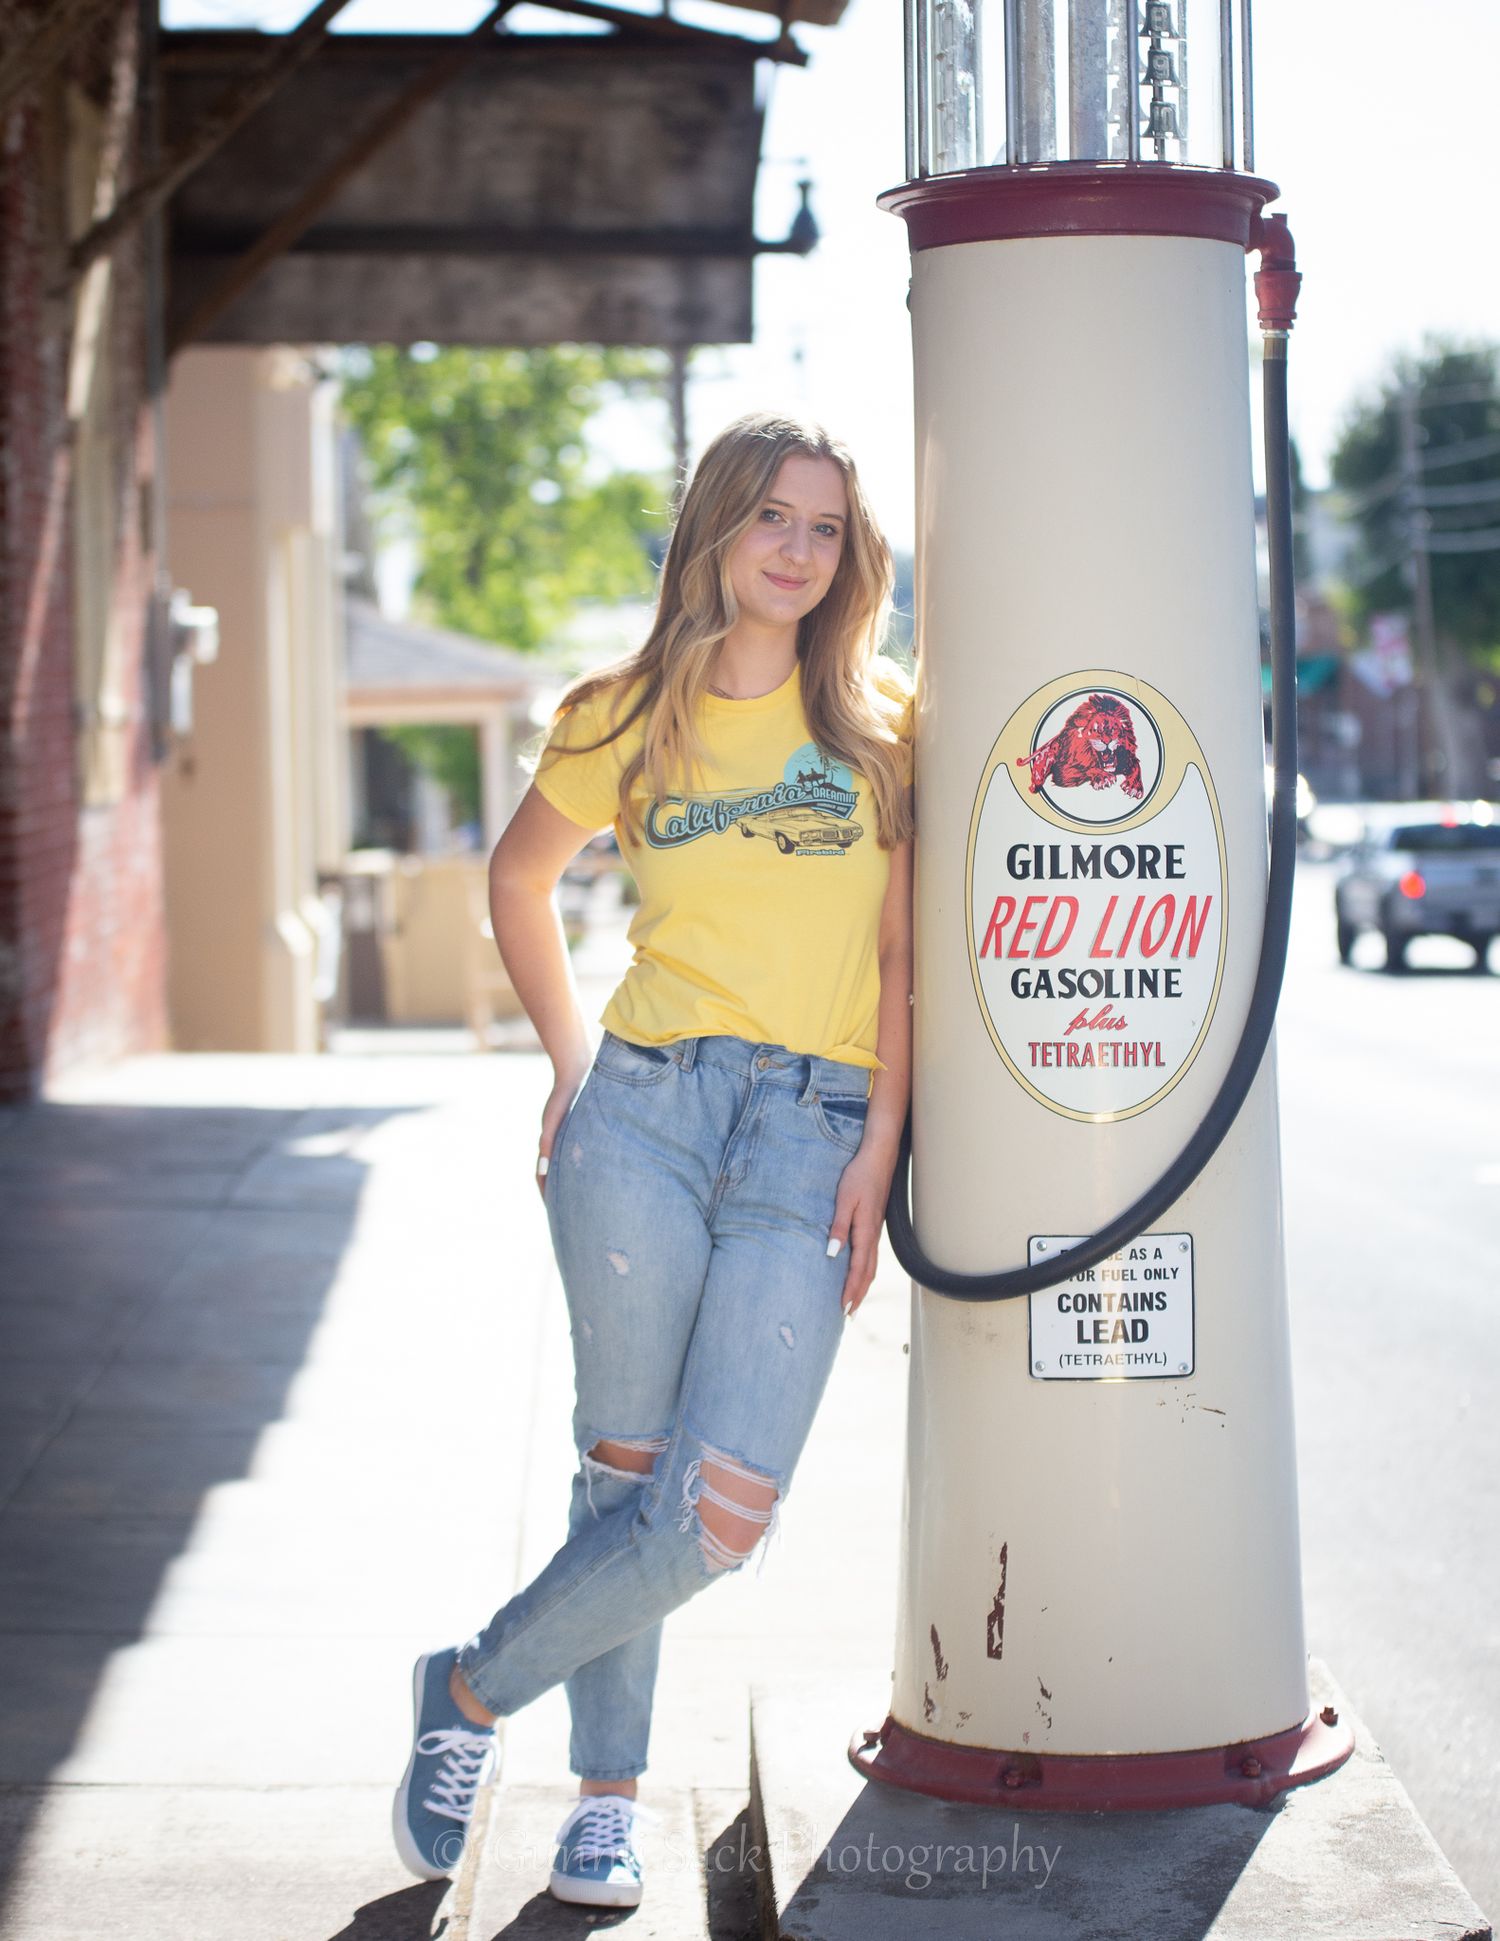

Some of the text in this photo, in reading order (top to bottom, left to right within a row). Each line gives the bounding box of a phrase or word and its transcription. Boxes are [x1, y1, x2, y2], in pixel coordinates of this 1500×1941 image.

[1152, 54, 1170, 80] 9
[1152, 105, 1174, 133] 10
[645, 783, 806, 849] California
[1006, 843, 1187, 881] GILMORE
[979, 893, 1213, 960] RED LION
[1010, 967, 1183, 999] GASOLINE
[1063, 1003, 1128, 1036] plus
[1027, 1041, 1166, 1068] TETRAETHYL
[1129, 1248, 1147, 1261] AS
[1153, 1247, 1163, 1260] A
[1101, 1269, 1138, 1282] FUEL
[1143, 1267, 1180, 1281] ONLY
[1057, 1291, 1168, 1314] CONTAINS
[1076, 1318, 1149, 1345] LEAD
[1058, 1352, 1168, 1369] (TETRAETHYL)
